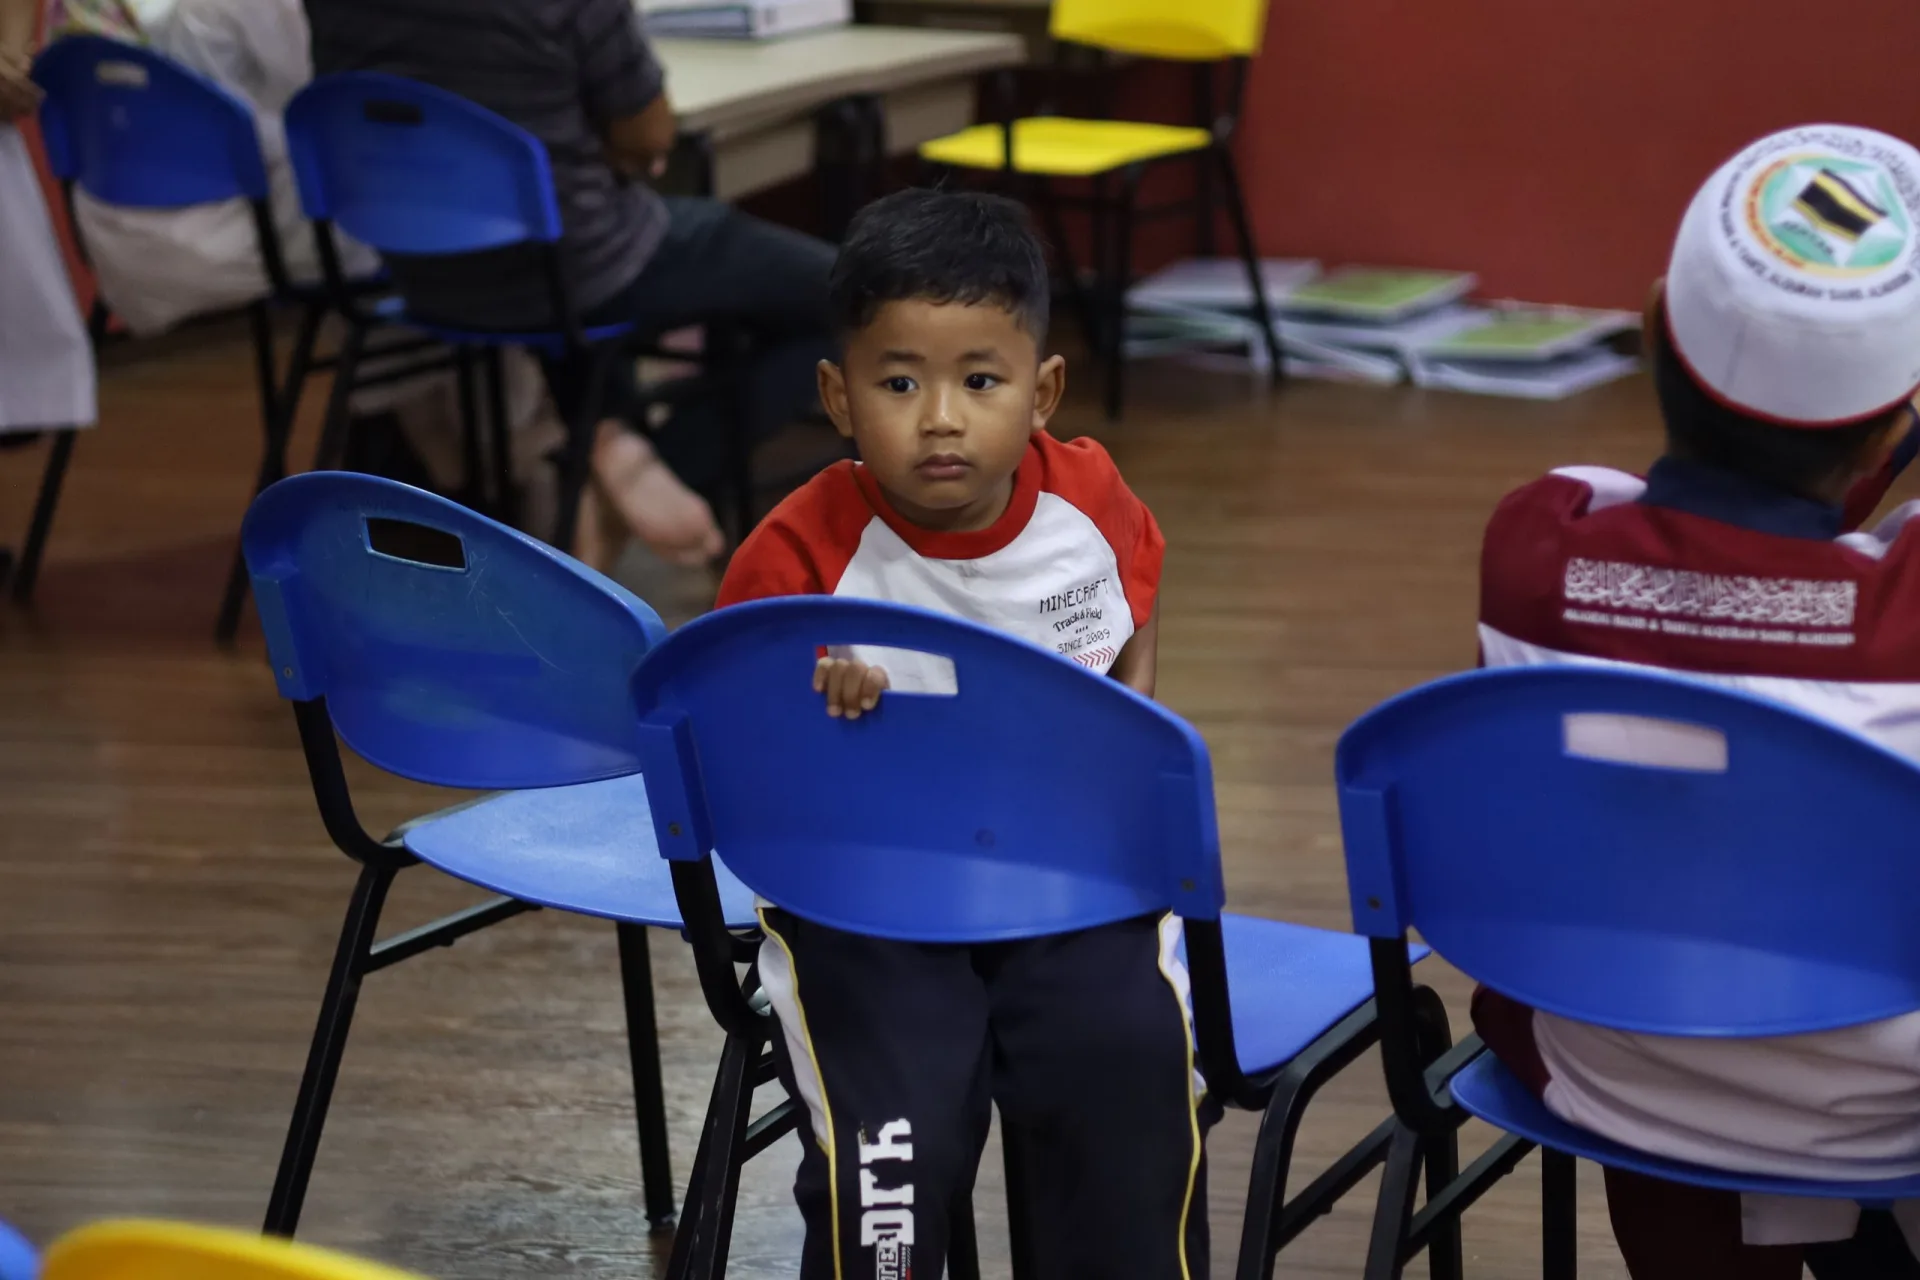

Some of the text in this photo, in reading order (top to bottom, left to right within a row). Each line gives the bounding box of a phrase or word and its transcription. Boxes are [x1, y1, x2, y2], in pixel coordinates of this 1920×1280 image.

[1039, 578, 1108, 614] MINECRAFT
[1057, 628, 1111, 654] SINCE 2009
